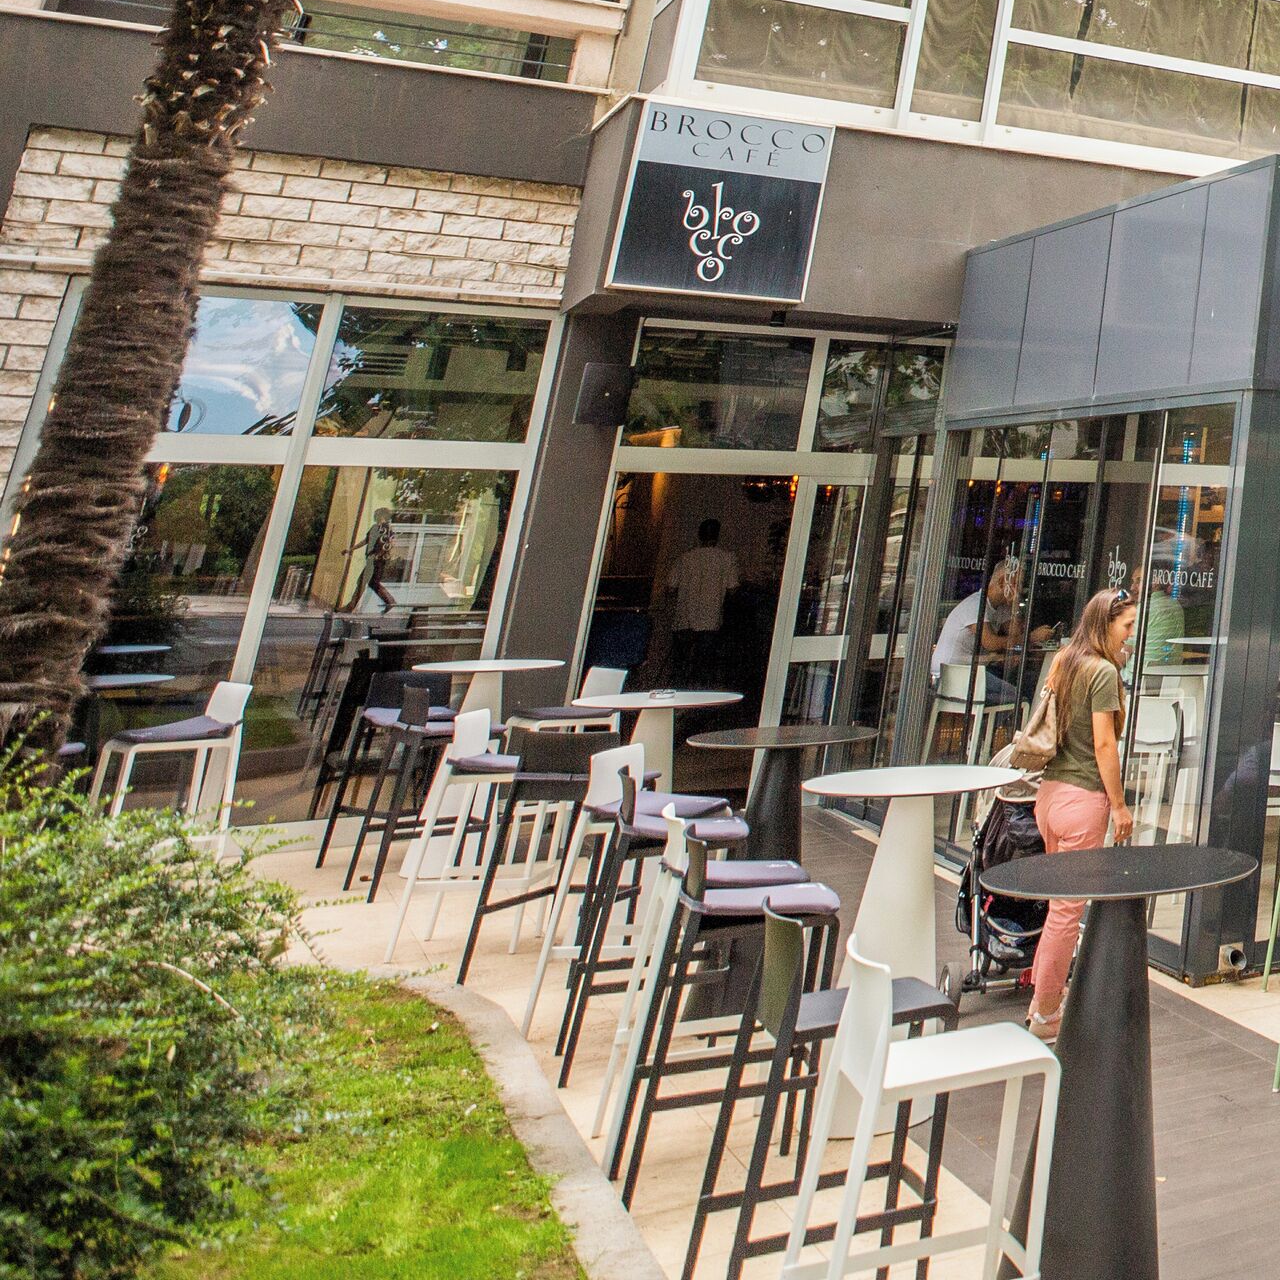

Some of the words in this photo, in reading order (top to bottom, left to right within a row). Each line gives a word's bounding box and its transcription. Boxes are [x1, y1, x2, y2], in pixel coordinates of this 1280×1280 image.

[650, 110, 826, 154] BROCCO
[692, 141, 779, 168] CAFÉ
[1037, 562, 1066, 578] BROCCO
[1067, 560, 1086, 579] CAFÉ
[1152, 569, 1188, 586] BROCCO
[1189, 568, 1214, 588] CAFÉ
